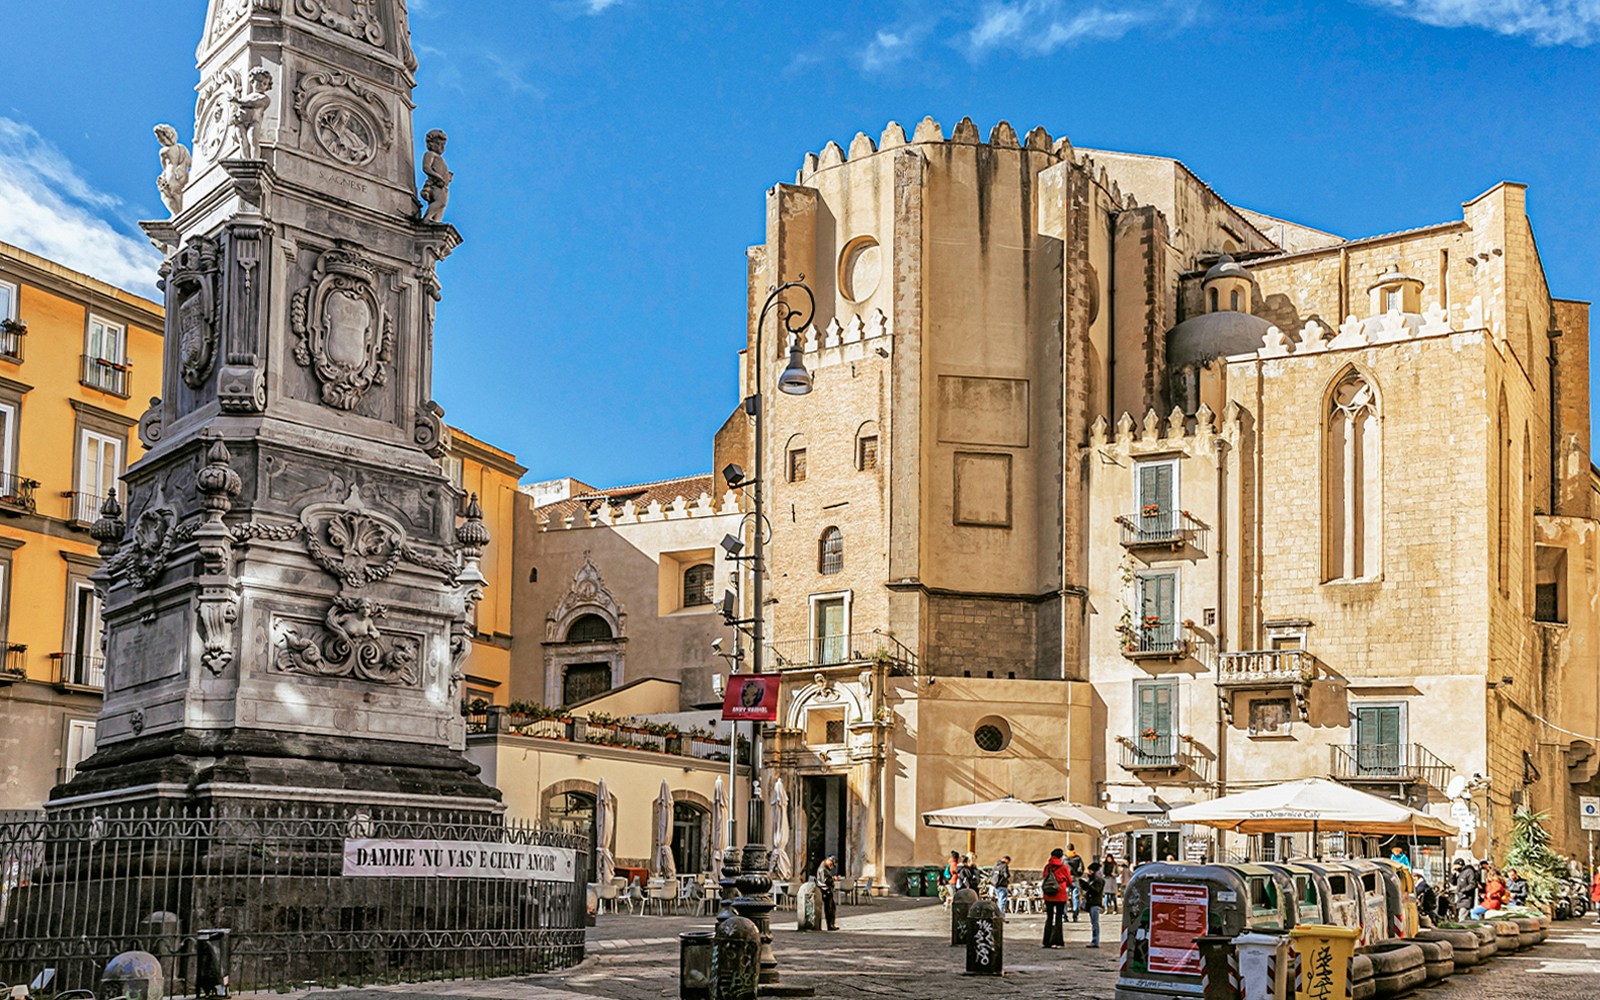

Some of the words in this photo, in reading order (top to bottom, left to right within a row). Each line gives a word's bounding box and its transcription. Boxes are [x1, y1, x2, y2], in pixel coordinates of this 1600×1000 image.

[328, 175, 367, 193] AGNESE
[1249, 810, 1264, 818] San
[1266, 810, 1302, 818] Domenico
[356, 848, 415, 867] DAMME
[419, 849, 443, 867] 'NU
[448, 849, 477, 868] VAS'
[479, 850, 487, 868] E
[526, 853, 557, 872] ANCOR'
